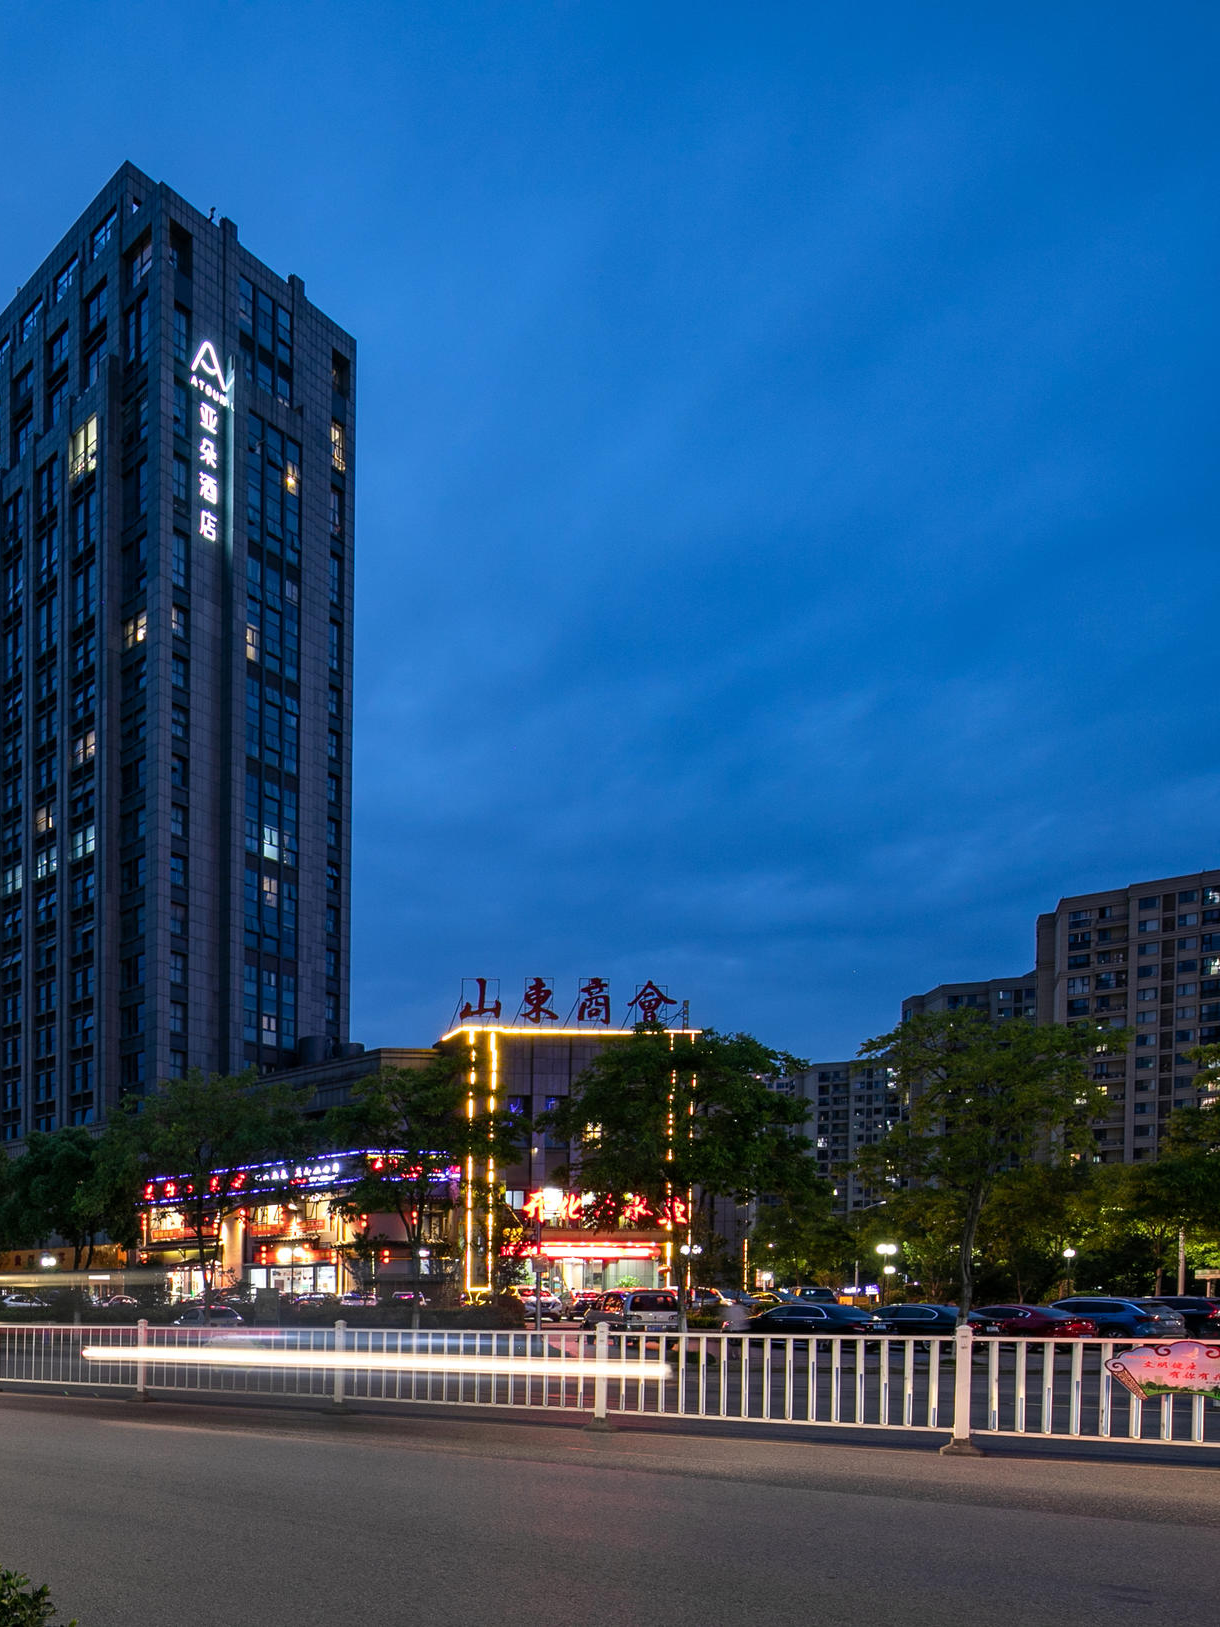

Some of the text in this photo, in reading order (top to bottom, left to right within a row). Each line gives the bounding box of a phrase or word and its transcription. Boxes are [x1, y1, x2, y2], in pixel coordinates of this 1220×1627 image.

[199, 402, 218, 542] 亚朵酒店
[459, 977, 678, 1024] 山東商會
